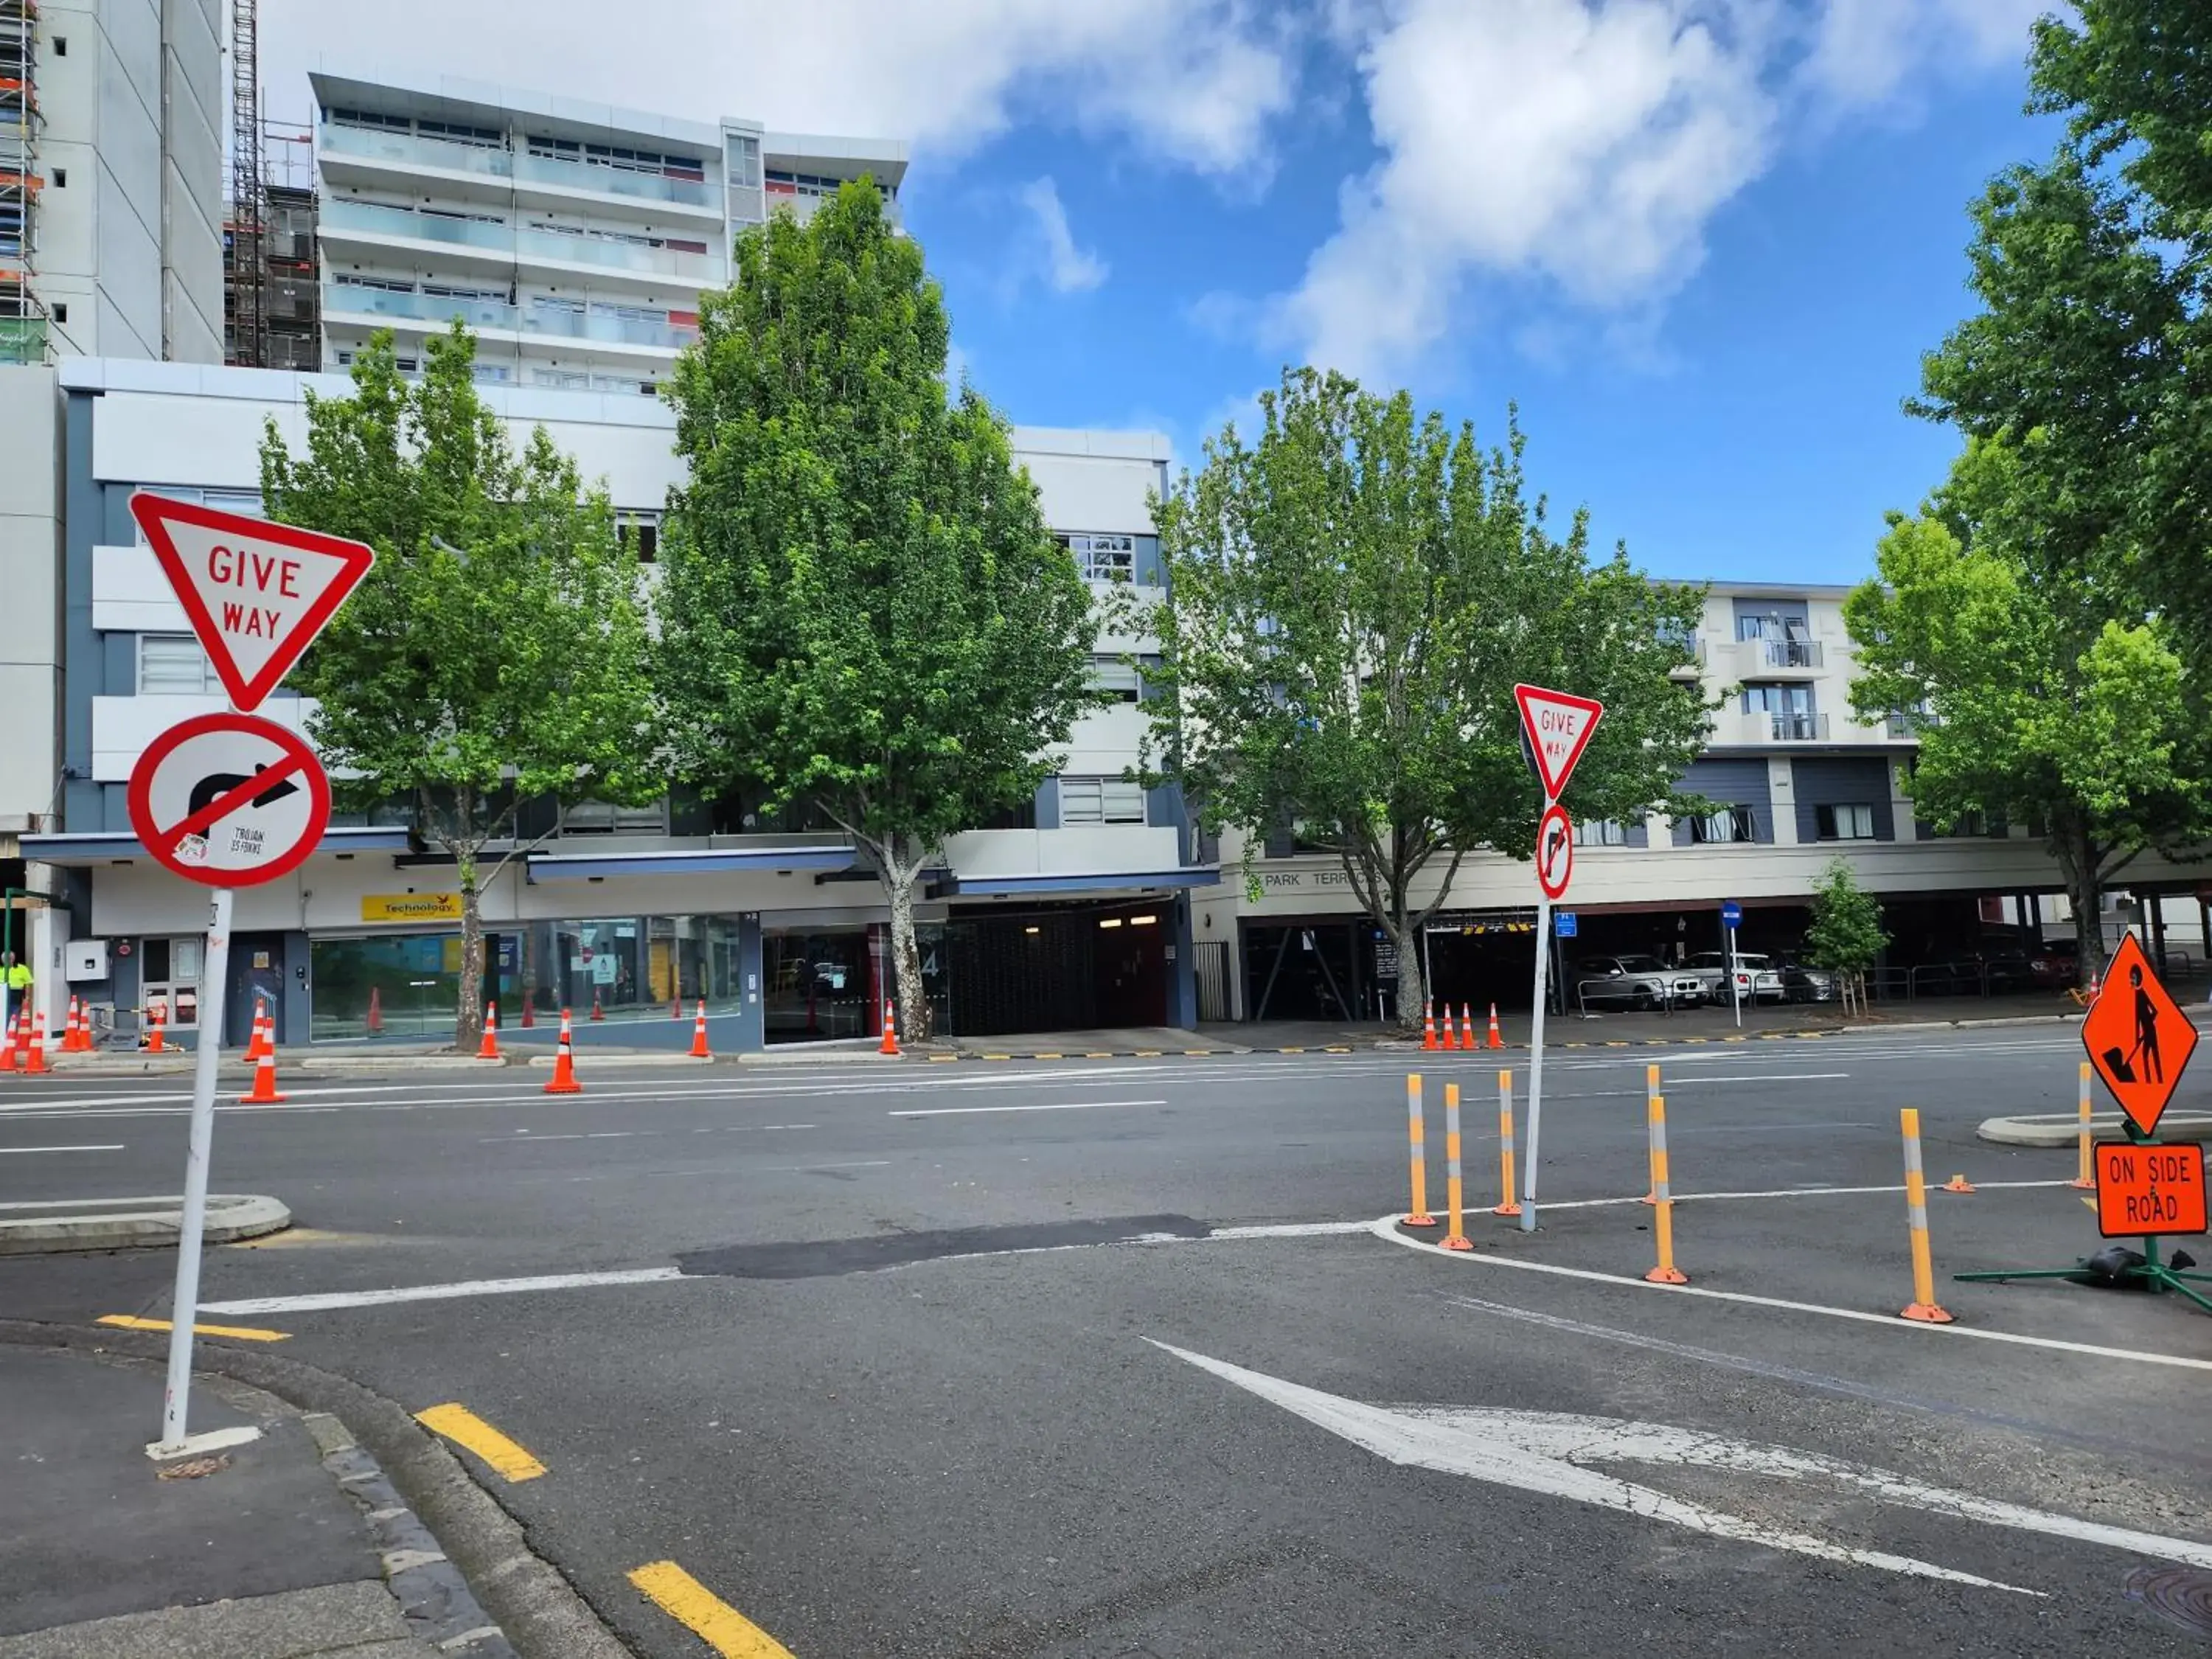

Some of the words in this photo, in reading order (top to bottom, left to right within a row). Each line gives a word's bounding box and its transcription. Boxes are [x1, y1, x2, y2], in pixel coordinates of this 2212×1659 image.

[209, 545, 301, 598] GIVE
[224, 602, 281, 639] WAY
[1542, 710, 1575, 735] GIVE
[1546, 742, 1566, 758] WAY
[1265, 874, 1300, 886] PARK
[1314, 872, 1382, 885] TERRCS
[2110, 1156, 2134, 1183] ON
[2148, 1156, 2191, 1183] SIDE
[2126, 1195, 2177, 1222] ROAD
